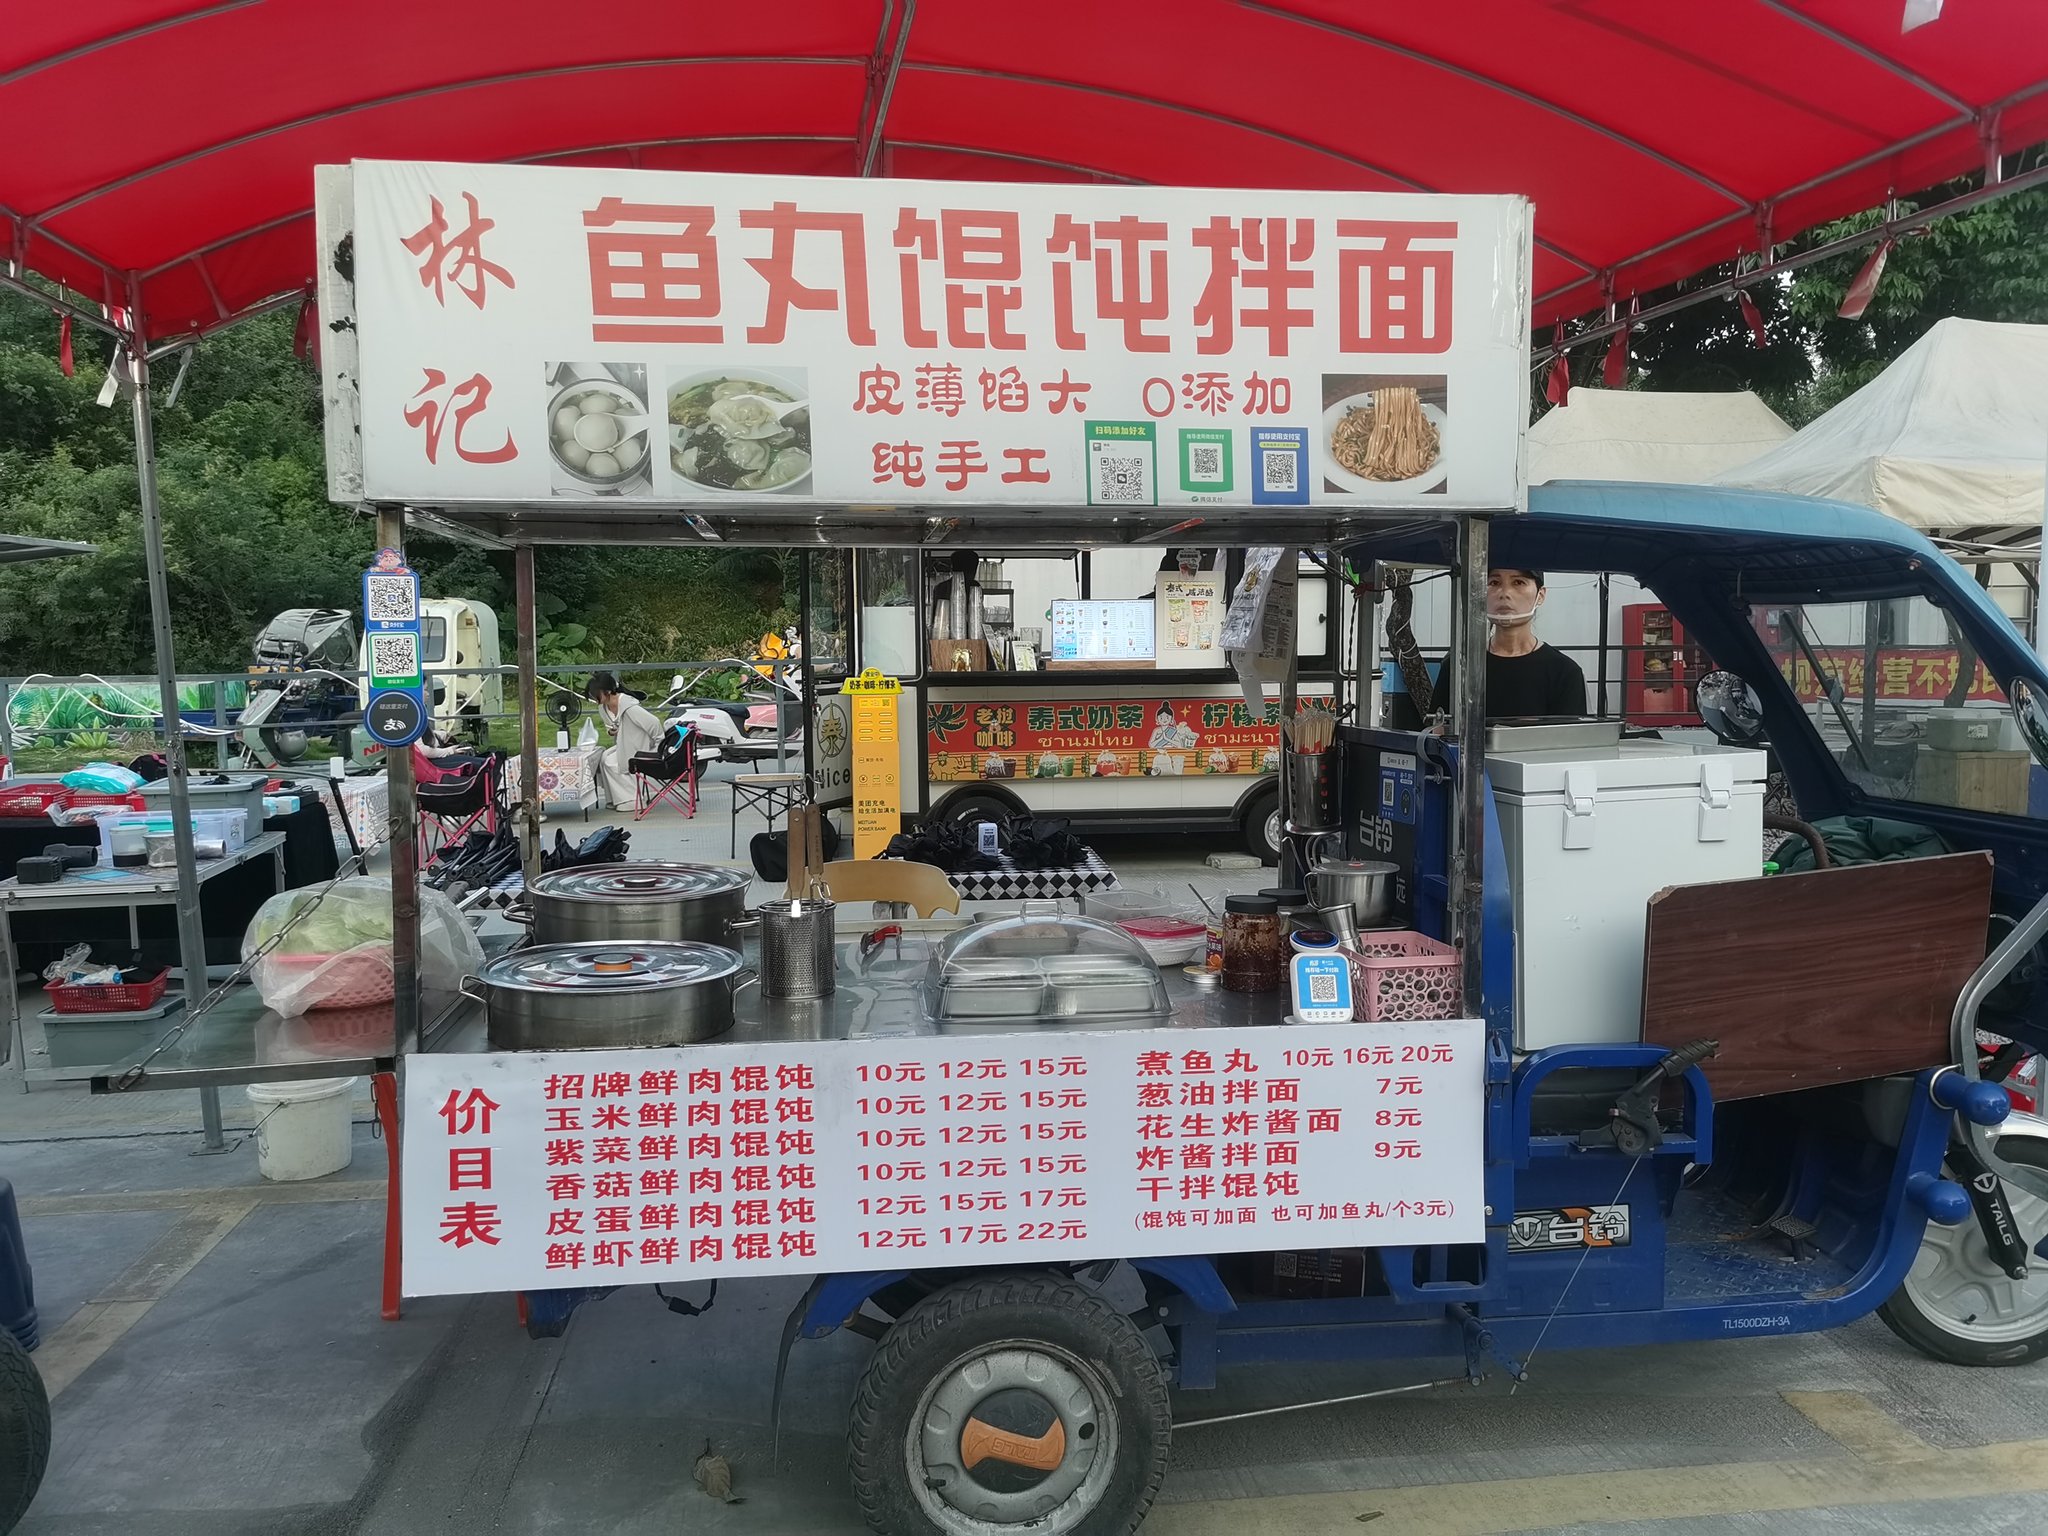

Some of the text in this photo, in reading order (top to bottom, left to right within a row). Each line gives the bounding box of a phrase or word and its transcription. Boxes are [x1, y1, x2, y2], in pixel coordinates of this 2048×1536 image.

[582, 196, 1459, 357] 鱼丸馄饨拌面
[402, 192, 518, 465] 林记
[853, 363, 1092, 417] 皮薄馅大
[872, 441, 1051, 492] 纯手工
[1028, 705, 1144, 731] 泰式奶茶
[976, 731, 1014, 747] 咖啡
[545, 1058, 1085, 1099] 招牌鲜肉馄饨 10元 12元 15元
[1138, 1047, 1452, 1076] 煮鱼丸 10元 16元 20元
[547, 1090, 1086, 1130] 玉米鲜肉馄饨 10元 12元 15元
[1139, 1078, 1421, 1107] 葱油拌面 7元
[547, 1122, 1086, 1165] 紫菜鲜肉馄饨 10元 12元 15元
[1139, 1110, 1420, 1139] 花生炸酱面 8元
[439, 1087, 501, 1249] 价目表
[1138, 1142, 1420, 1170] 炸酱拌面 9元
[549, 1158, 1085, 1200] 香菇鲜肉馄饨 10元 12元 15元
[1140, 1172, 1298, 1201] 干拌馄饨
[547, 1189, 1084, 1234] 皮蛋鲜肉馄饨 12元 15元 17元
[1548, 1211, 1627, 1243] 台铃
[1990, 1198, 2014, 1246] TAILG
[547, 1224, 1085, 1268] 鲜虾鲜肉馄饨 12元 17元 22元
[1722, 1316, 1790, 1329] TL1500DZH-3A
